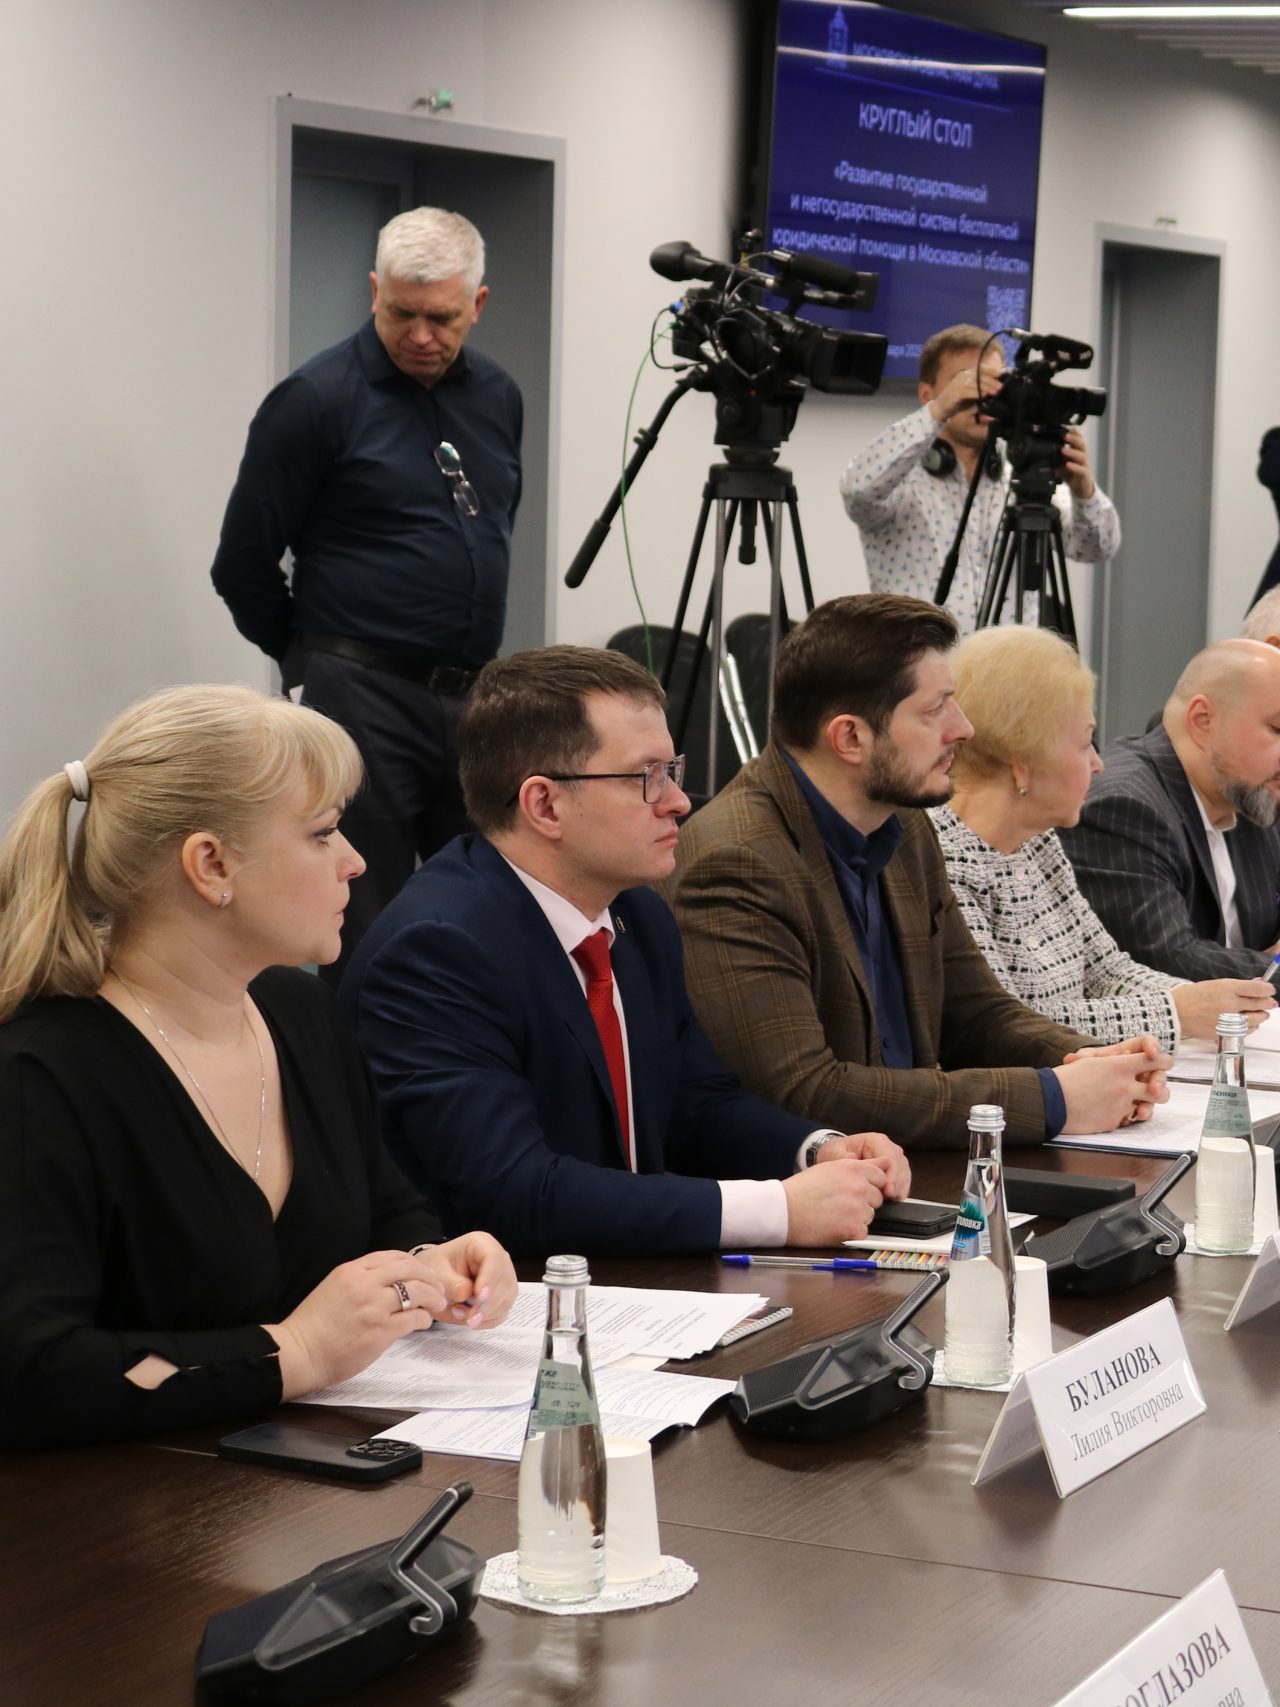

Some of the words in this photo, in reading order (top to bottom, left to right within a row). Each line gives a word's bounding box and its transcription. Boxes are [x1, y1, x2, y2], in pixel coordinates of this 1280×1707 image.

[859, 102, 932, 140] КРУГЛЫЙ
[933, 118, 973, 148] СТОЛ
[896, 174, 988, 203] государственной
[802, 194, 916, 227] негосударственной
[919, 212, 957, 232] систем
[959, 213, 1018, 241] бесплатной
[773, 227, 857, 253] юридической
[859, 238, 907, 261] помощи
[918, 242, 983, 268] Московской
[1065, 1341, 1161, 1413] БУЛАНОВА
[1070, 1423, 1114, 1462] Лилия
[1110, 1383, 1184, 1437] Викторовна
[1116, 1623, 1232, 1707] ГЛАЗОВА
